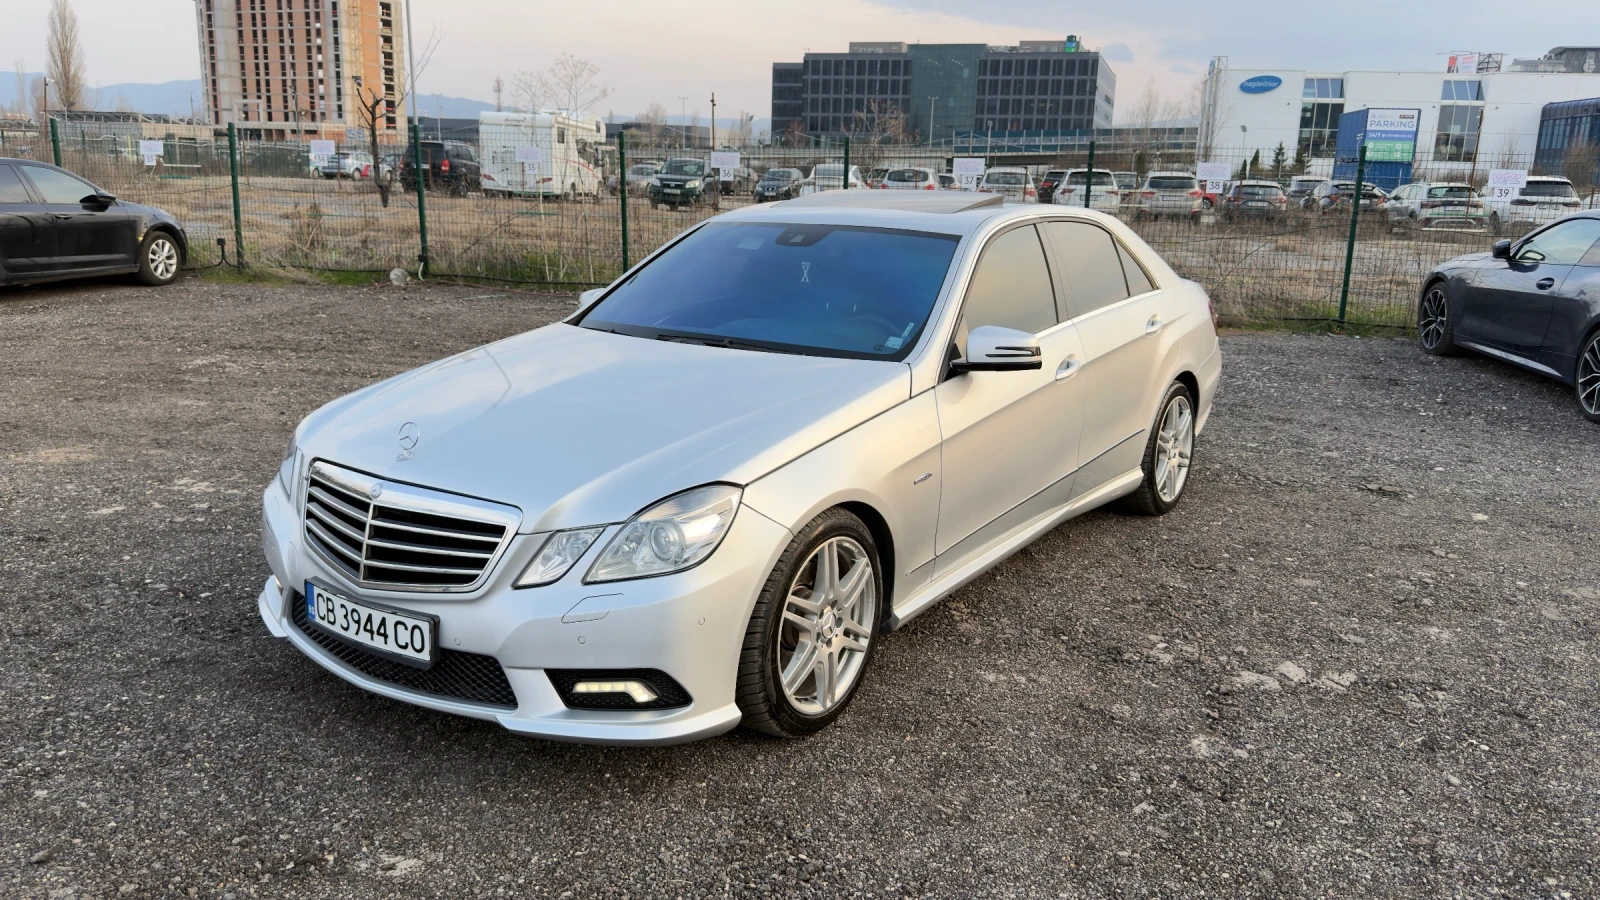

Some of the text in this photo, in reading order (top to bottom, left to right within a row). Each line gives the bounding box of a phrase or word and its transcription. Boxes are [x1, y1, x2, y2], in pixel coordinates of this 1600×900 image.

[1369, 120, 1415, 128] PARKING
[527, 163, 536, 171] 35
[721, 169, 732, 178] 36
[964, 176, 975, 185] 37
[1209, 181, 1221, 190] 38
[1496, 188, 1510, 198] 39
[316, 592, 425, 653] CB 3944 CO
